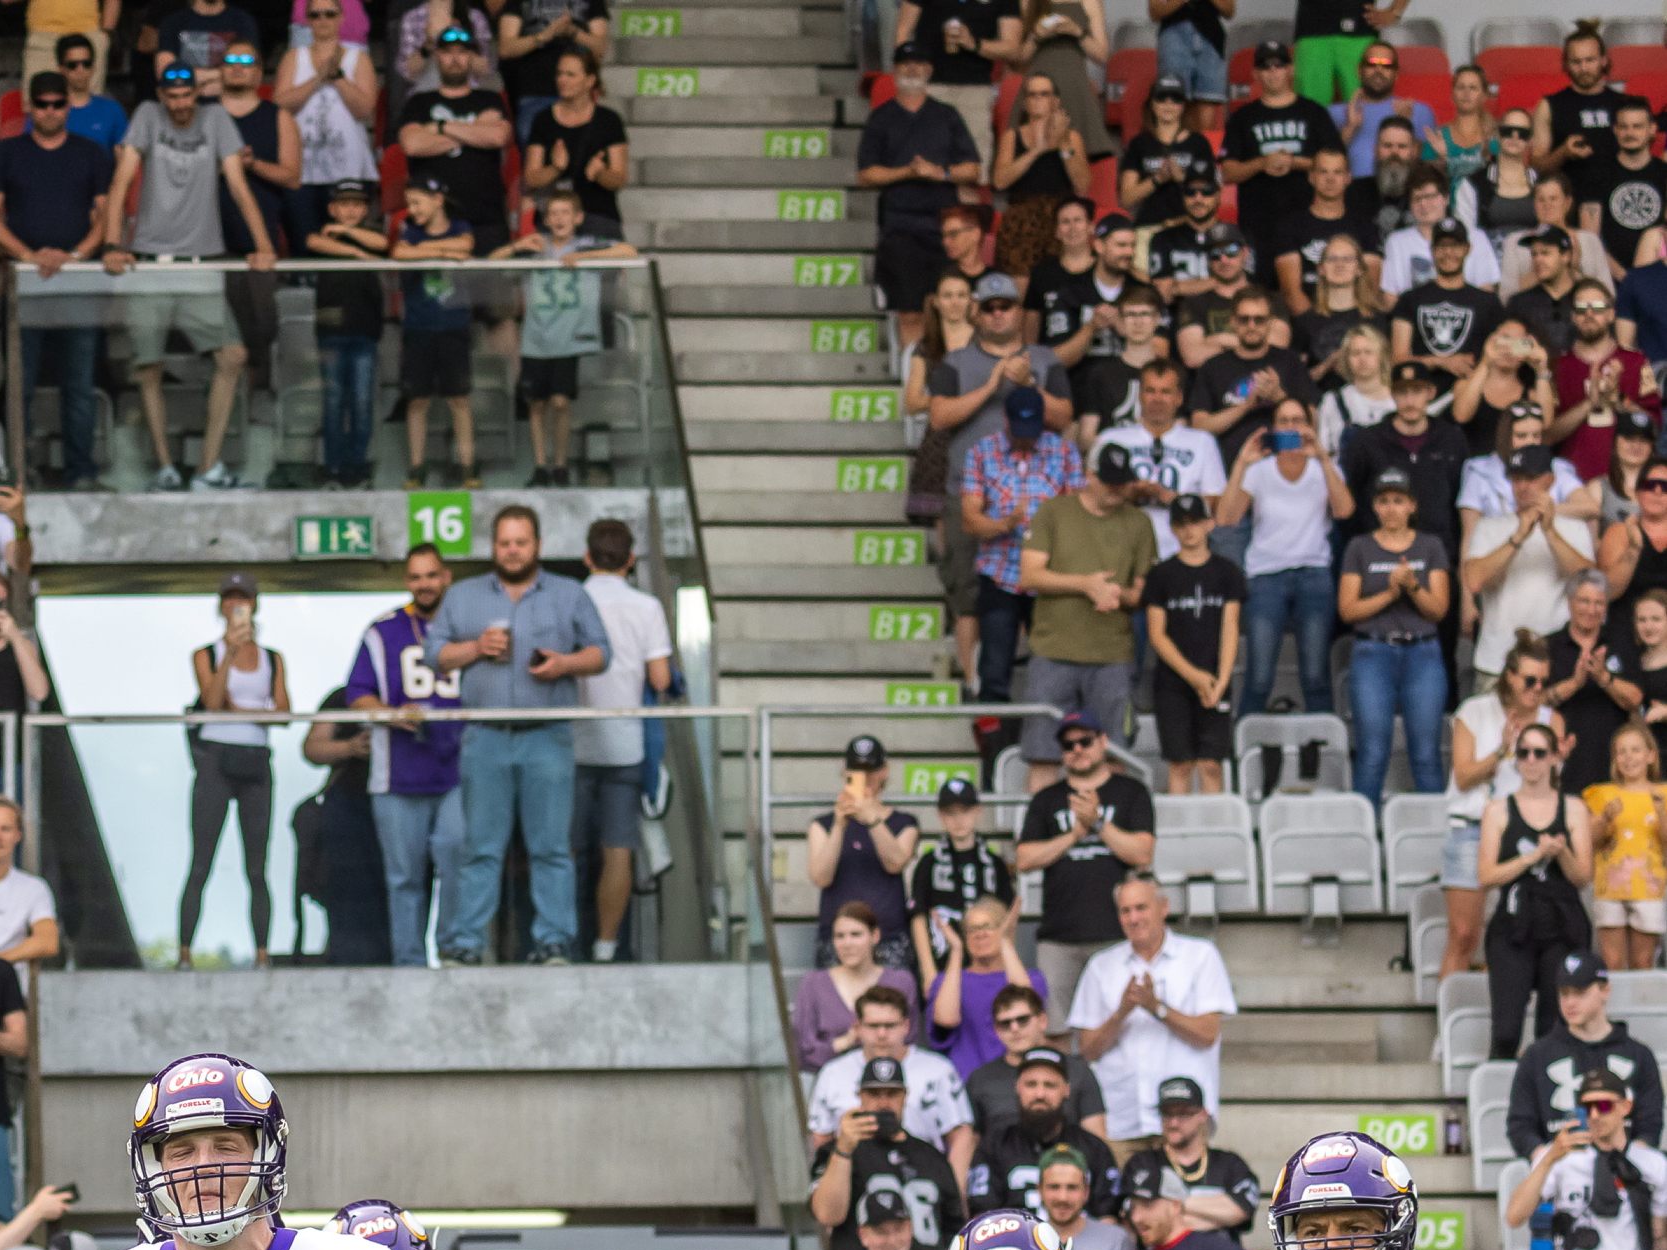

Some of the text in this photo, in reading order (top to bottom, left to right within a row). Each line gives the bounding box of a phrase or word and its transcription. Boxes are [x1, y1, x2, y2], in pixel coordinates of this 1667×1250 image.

[784, 195, 838, 221] B18
[798, 262, 855, 287] B17
[814, 326, 872, 353] B16
[835, 395, 892, 422] B15
[843, 464, 899, 491] B14
[414, 505, 465, 542] 16
[860, 535, 916, 565] B13
[874, 610, 933, 640] B12
[910, 768, 971, 795] B1
[169, 1068, 224, 1093] Chio
[178, 1099, 212, 1109] FORELLE
[1367, 1119, 1429, 1151] B06
[353, 1211, 396, 1238] Chio
[974, 1219, 1020, 1242] Chio
[1418, 1218, 1459, 1250] 05
